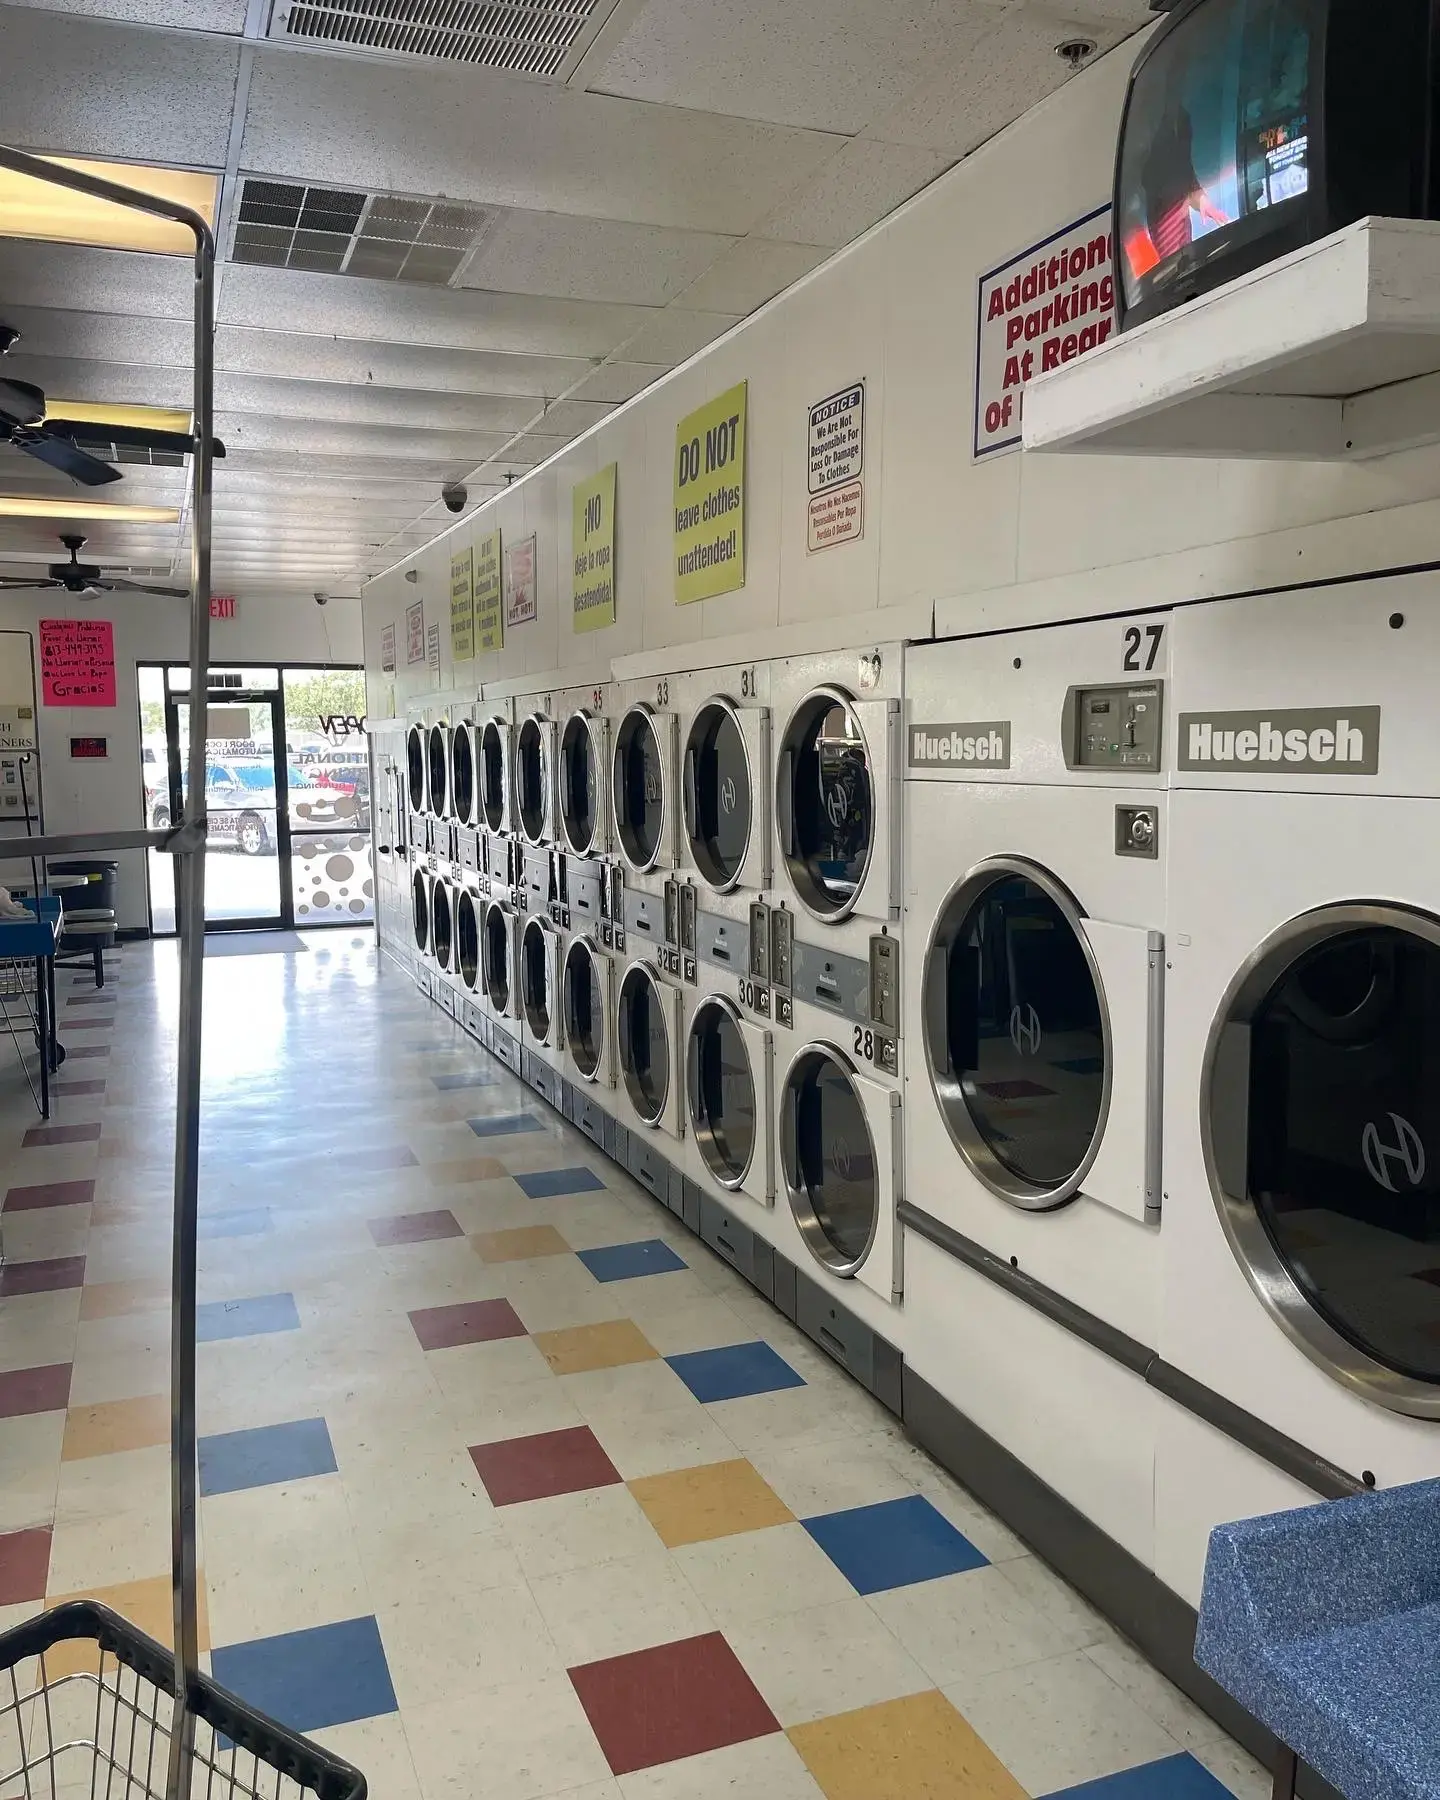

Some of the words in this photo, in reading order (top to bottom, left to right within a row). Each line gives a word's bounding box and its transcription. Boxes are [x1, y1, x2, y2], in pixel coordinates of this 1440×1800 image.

[1006, 274, 1113, 351] Parking
[1002, 349, 1034, 390] At
[1042, 317, 1111, 373] Rear
[814, 394, 856, 423] NOTICE
[984, 394, 1012, 433] Of
[816, 427, 826, 440] We
[827, 422, 838, 436] Are
[839, 414, 852, 430] Not
[678, 437, 700, 487] DO
[705, 414, 739, 474] NOT
[810, 434, 847, 458] Responsible
[847, 428, 859, 441] For
[811, 460, 823, 473] Loss
[824, 455, 833, 466] Or
[833, 444, 859, 463] Damage
[818, 472, 825, 484] To
[826, 463, 850, 481] Clothes
[675, 502, 700, 533] leave
[702, 485, 740, 522] clothes
[678, 529, 736, 577] unattended!
[209, 598, 236, 618] EXIT
[1123, 624, 1165, 671] 27
[52, 681, 105, 697] Gracias
[657, 682, 669, 706] 33
[741, 672, 756, 698] 31
[913, 731, 1003, 761] Huebsch
[1187, 719, 1364, 762] Huebsch
[657, 946, 668, 971] 32
[739, 978, 754, 1009] 30
[854, 1025, 874, 1061] 28
